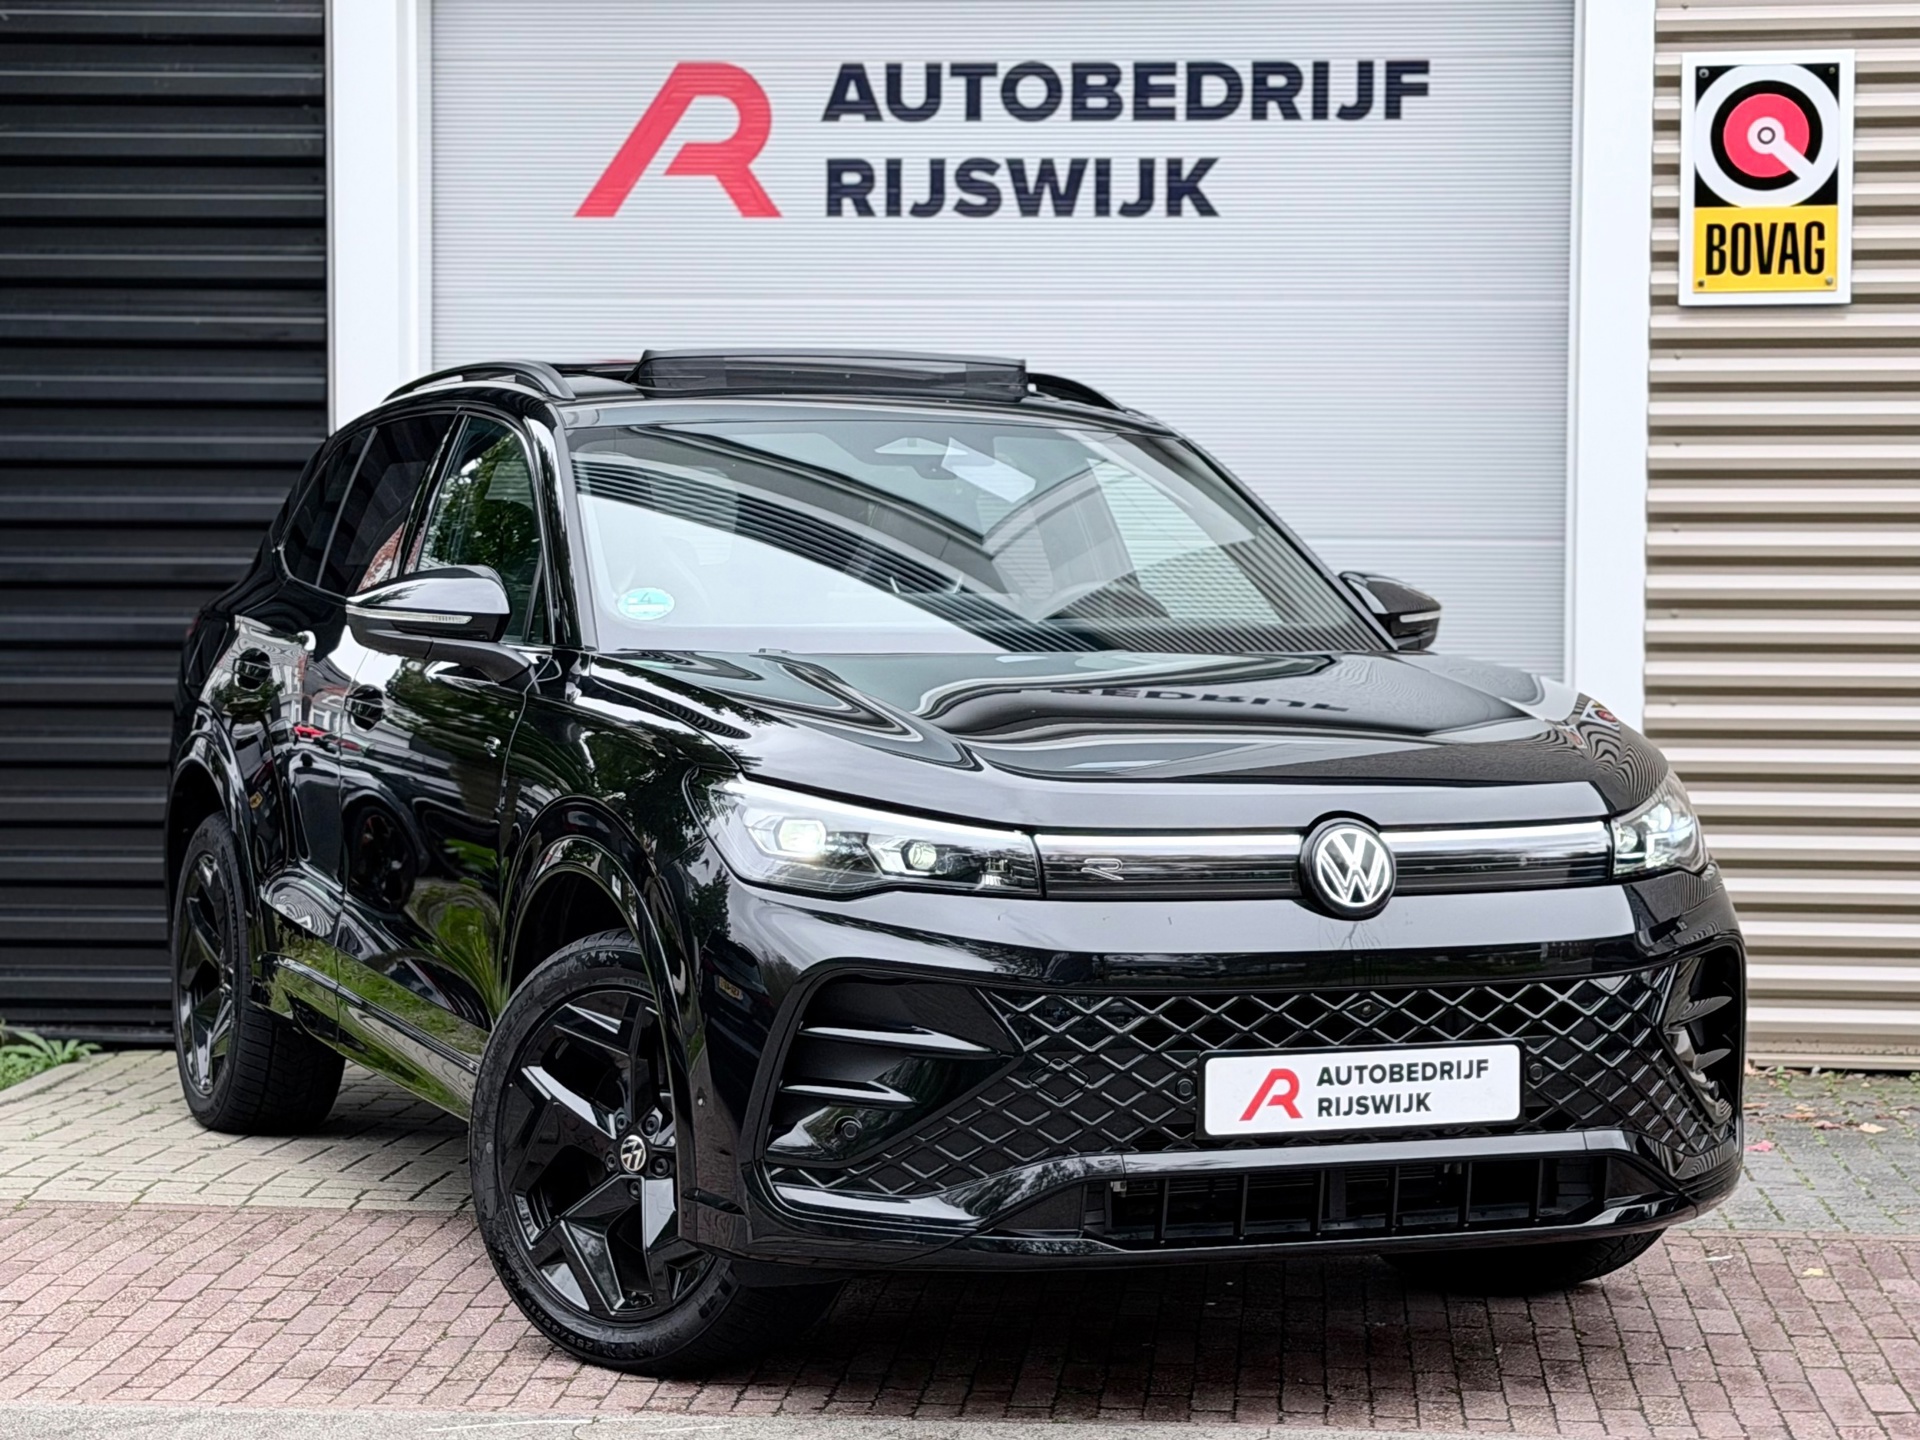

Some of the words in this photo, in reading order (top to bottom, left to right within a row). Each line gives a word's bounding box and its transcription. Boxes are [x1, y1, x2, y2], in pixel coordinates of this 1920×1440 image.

[822, 60, 1430, 122] AUTOBEDRIJF
[825, 158, 1220, 216] RIJSWIJK
[1705, 221, 1826, 276] BOVAG
[1316, 1059, 1489, 1087] AUTOBEDRIJF
[1317, 1092, 1432, 1118] RIJSWIJK
